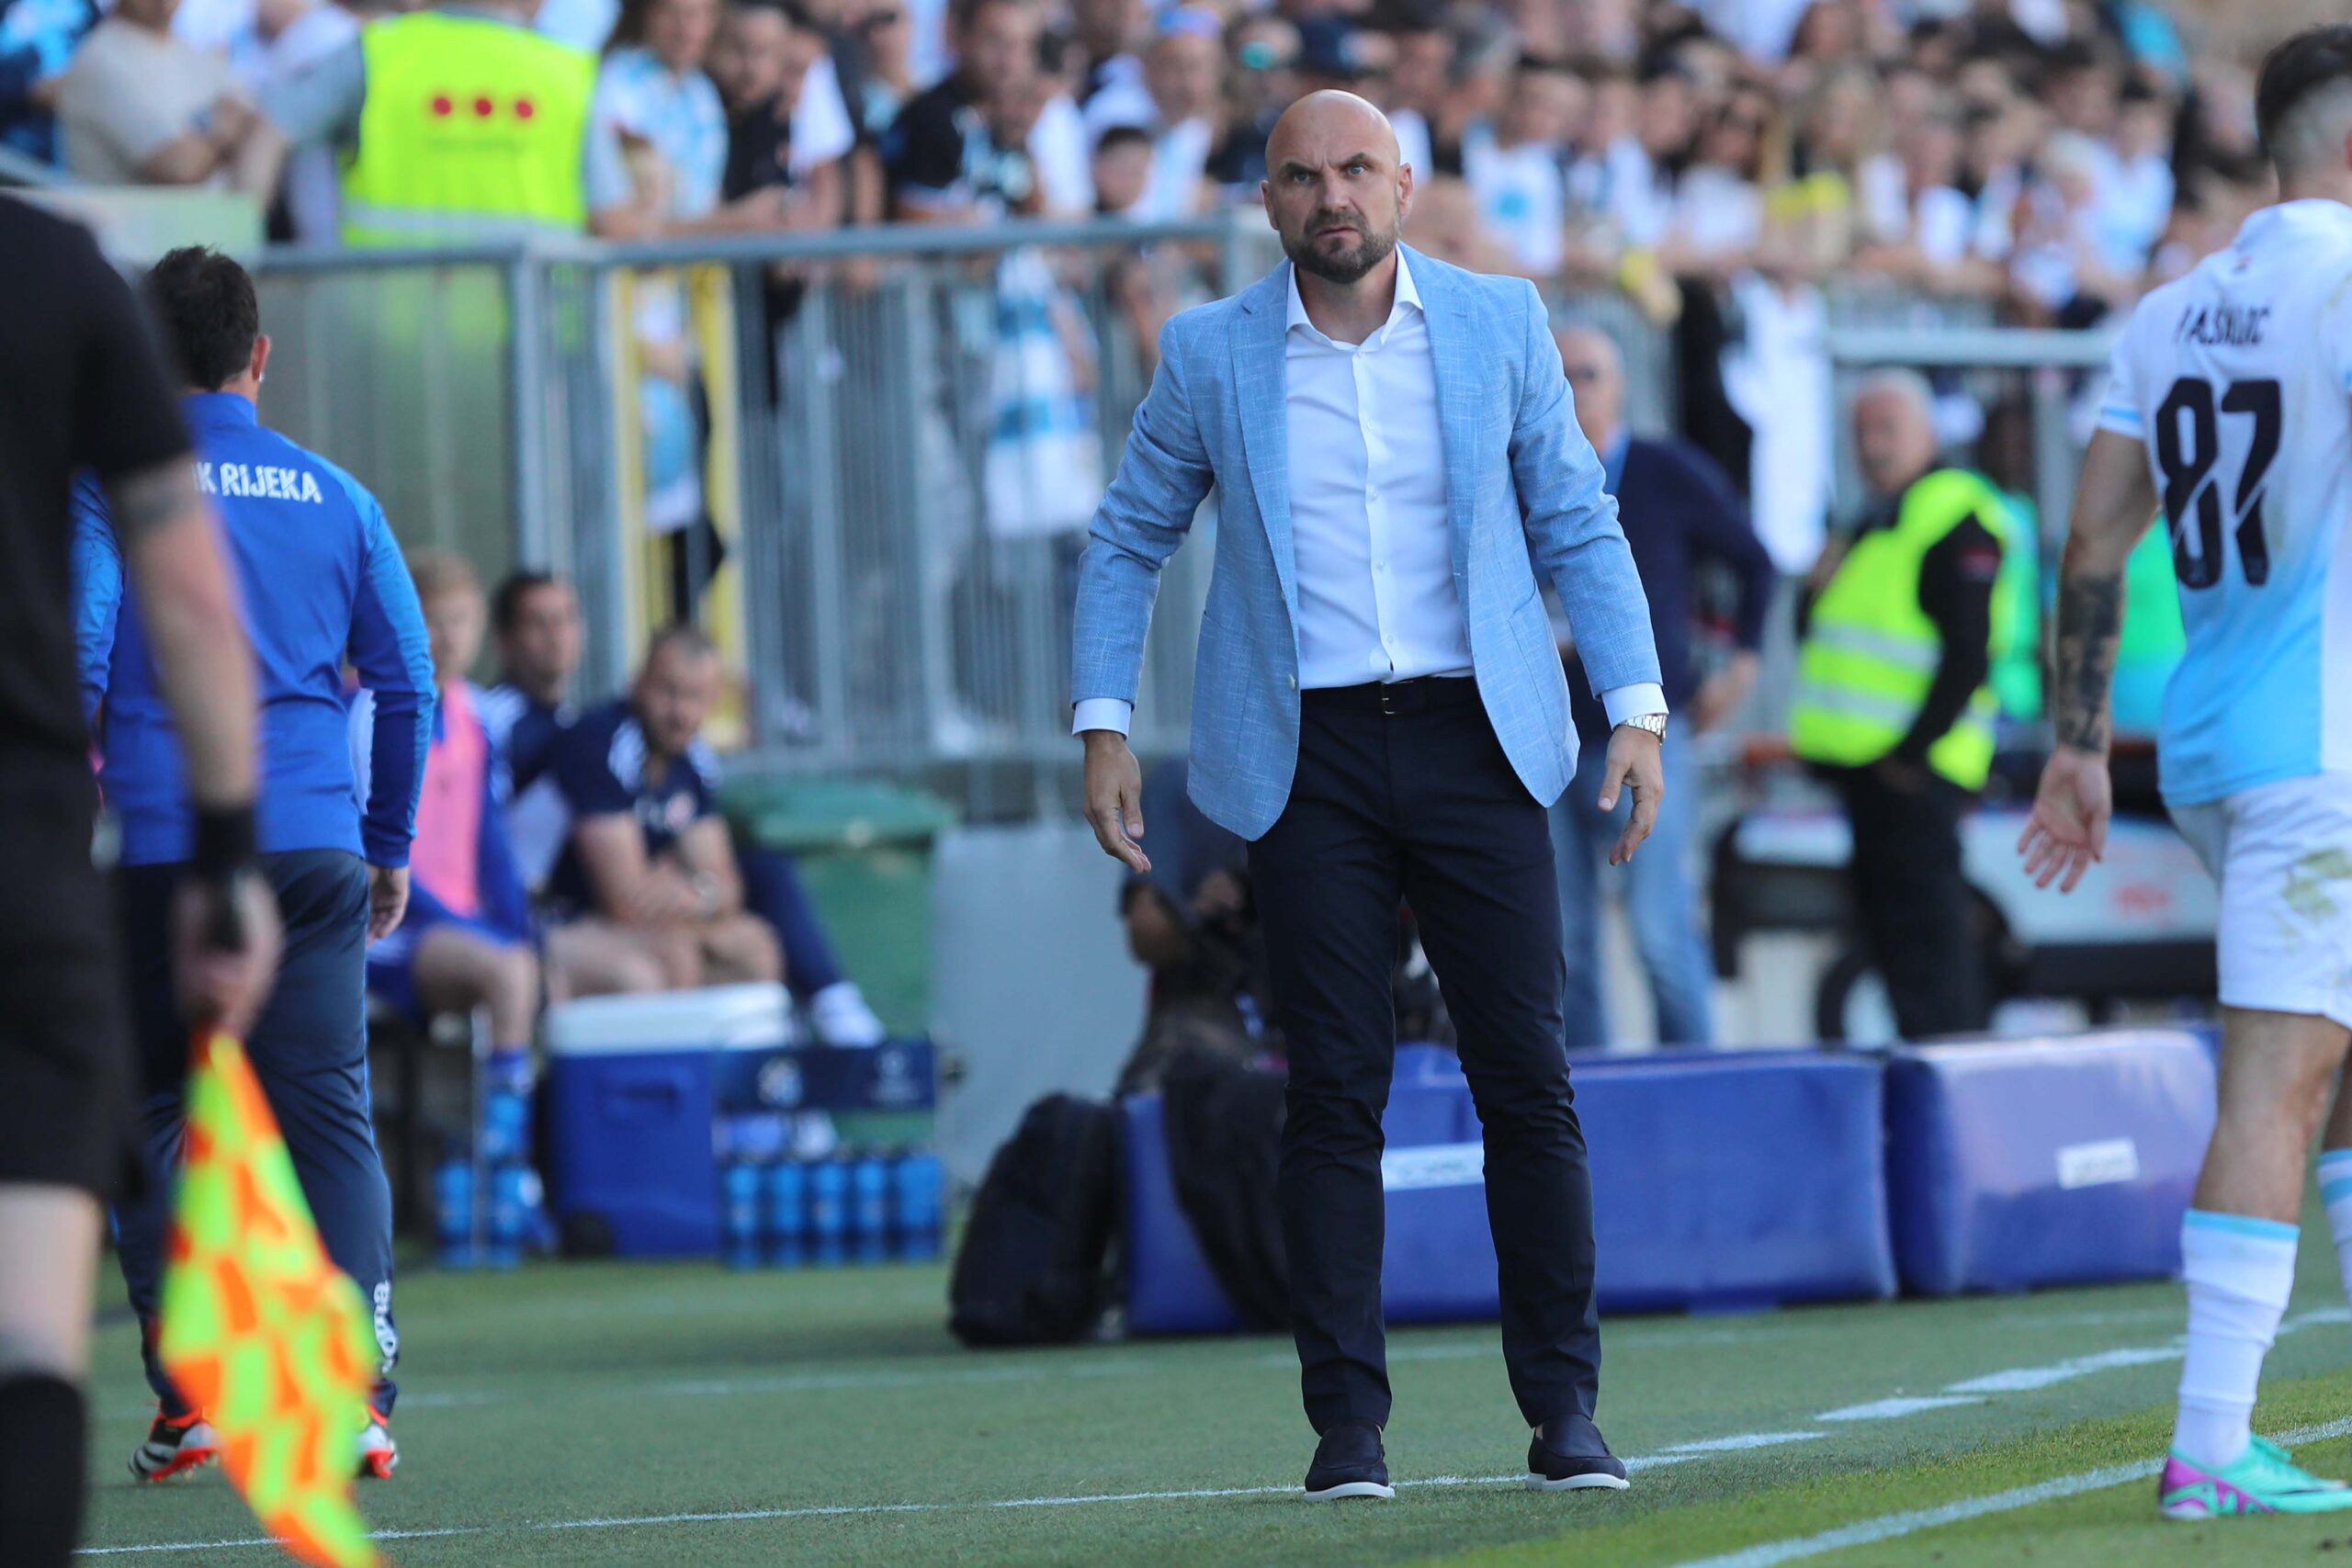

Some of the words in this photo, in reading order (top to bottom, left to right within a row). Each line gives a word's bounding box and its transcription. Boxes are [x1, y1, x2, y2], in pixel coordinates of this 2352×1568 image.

[191, 461, 218, 494] K
[220, 462, 323, 504] RIJEKA
[2156, 377, 2281, 589] 87
